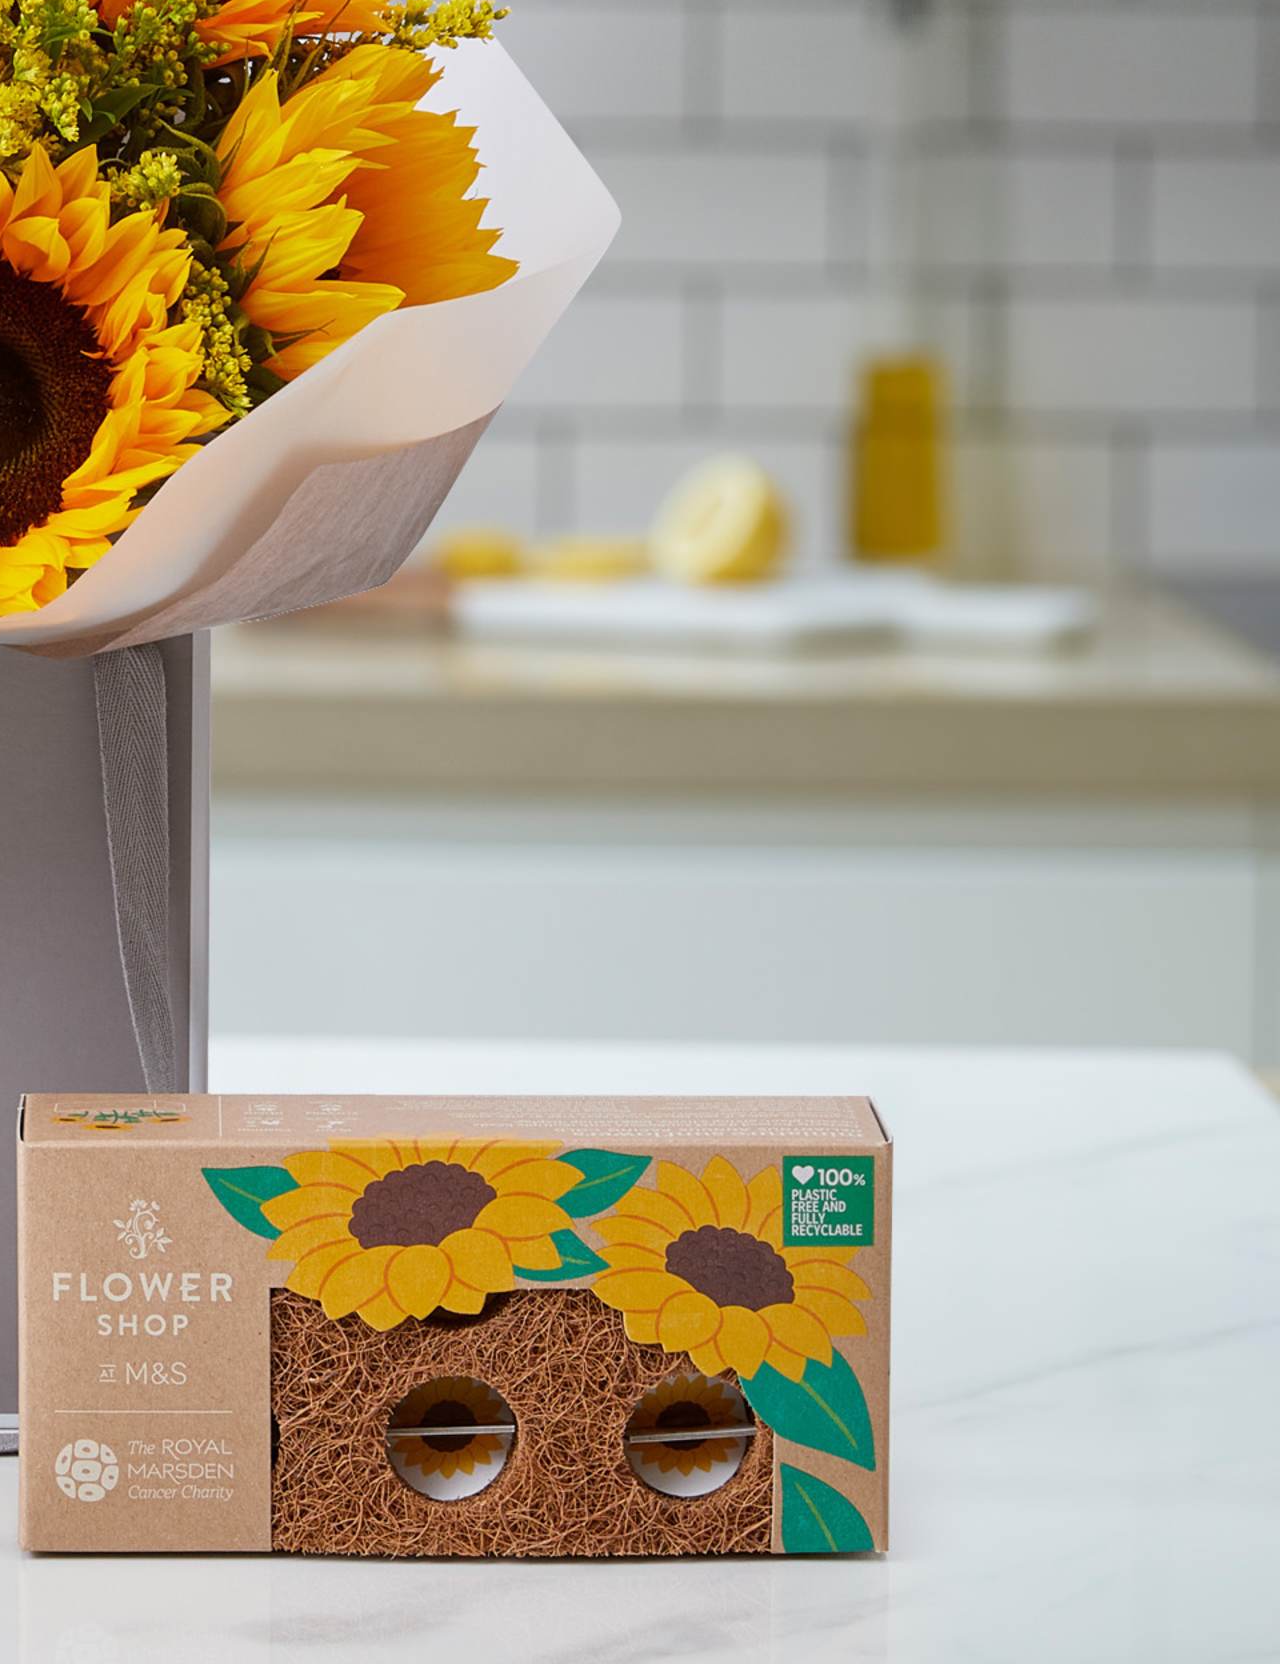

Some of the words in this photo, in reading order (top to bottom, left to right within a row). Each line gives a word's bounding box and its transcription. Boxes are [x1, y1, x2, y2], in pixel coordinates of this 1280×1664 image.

[817, 1167, 866, 1186] 100%
[791, 1189, 837, 1201] PLASTIC
[791, 1201, 819, 1213] FREE
[822, 1201, 847, 1213] AND
[791, 1213, 826, 1224] FULLY
[791, 1224, 863, 1236] RECYCLABLE
[52, 1272, 233, 1302] FLOWER
[97, 1313, 189, 1337] SHOP
[125, 1361, 188, 1385] M&S
[127, 1439, 156, 1456] The
[162, 1439, 233, 1461] ROYAL
[127, 1463, 235, 1485] MARSDEN
[127, 1485, 178, 1500] Cancer
[181, 1485, 234, 1502] Charity
